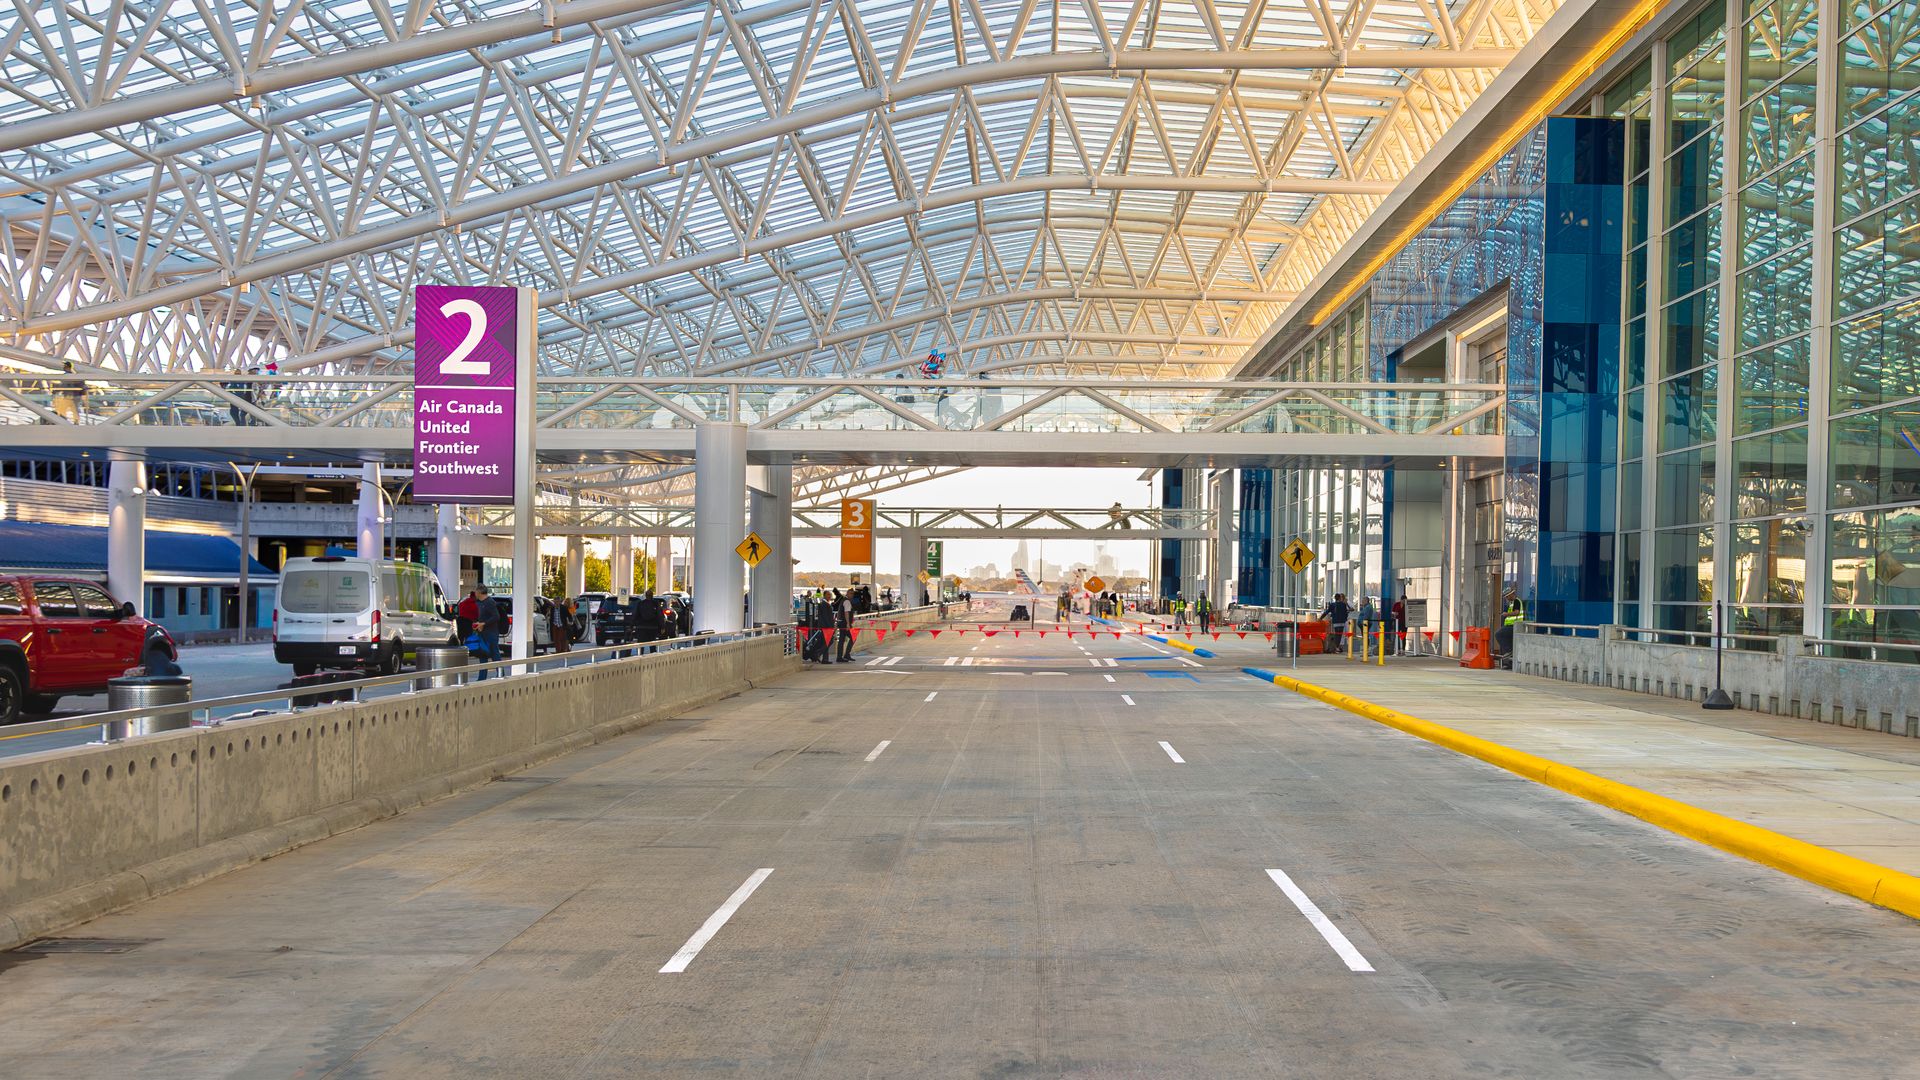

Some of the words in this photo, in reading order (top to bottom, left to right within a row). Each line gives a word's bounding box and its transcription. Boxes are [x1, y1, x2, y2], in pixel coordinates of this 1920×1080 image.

[439, 299, 491, 375] 2
[419, 400, 442, 414] Air
[446, 400, 503, 415] Canada
[419, 420, 470, 434] United
[419, 441, 480, 455] Frontier
[419, 461, 499, 475] Southwest
[848, 502, 864, 527] 3
[927, 542, 938, 556] 4
